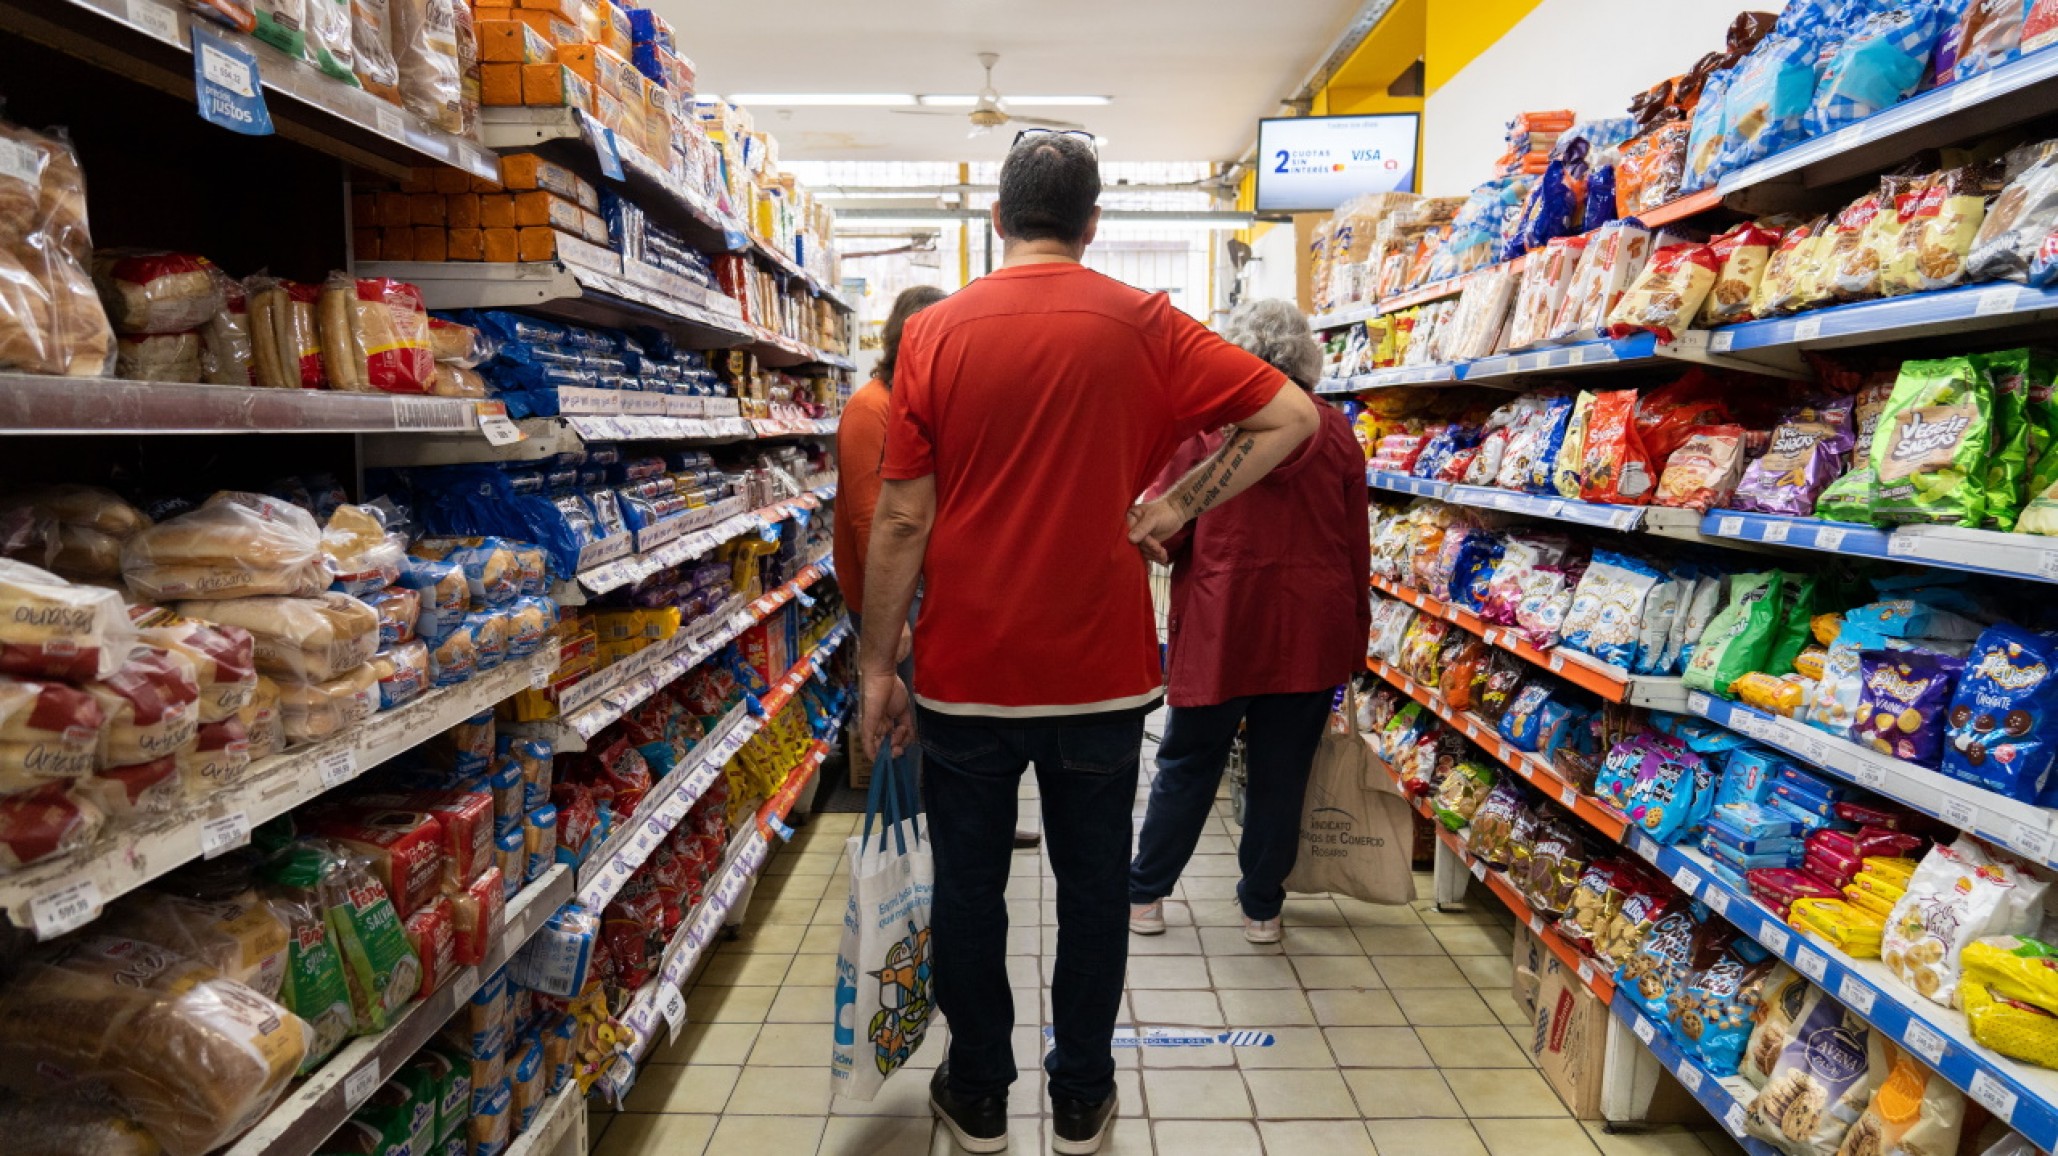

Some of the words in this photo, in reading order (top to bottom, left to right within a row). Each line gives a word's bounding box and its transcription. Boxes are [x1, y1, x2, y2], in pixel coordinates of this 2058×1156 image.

[213, 98, 254, 124] justos
[1274, 149, 1290, 174] 2
[1352, 149, 1381, 161] VISA
[1815, 1041, 1858, 1069] AVENA
